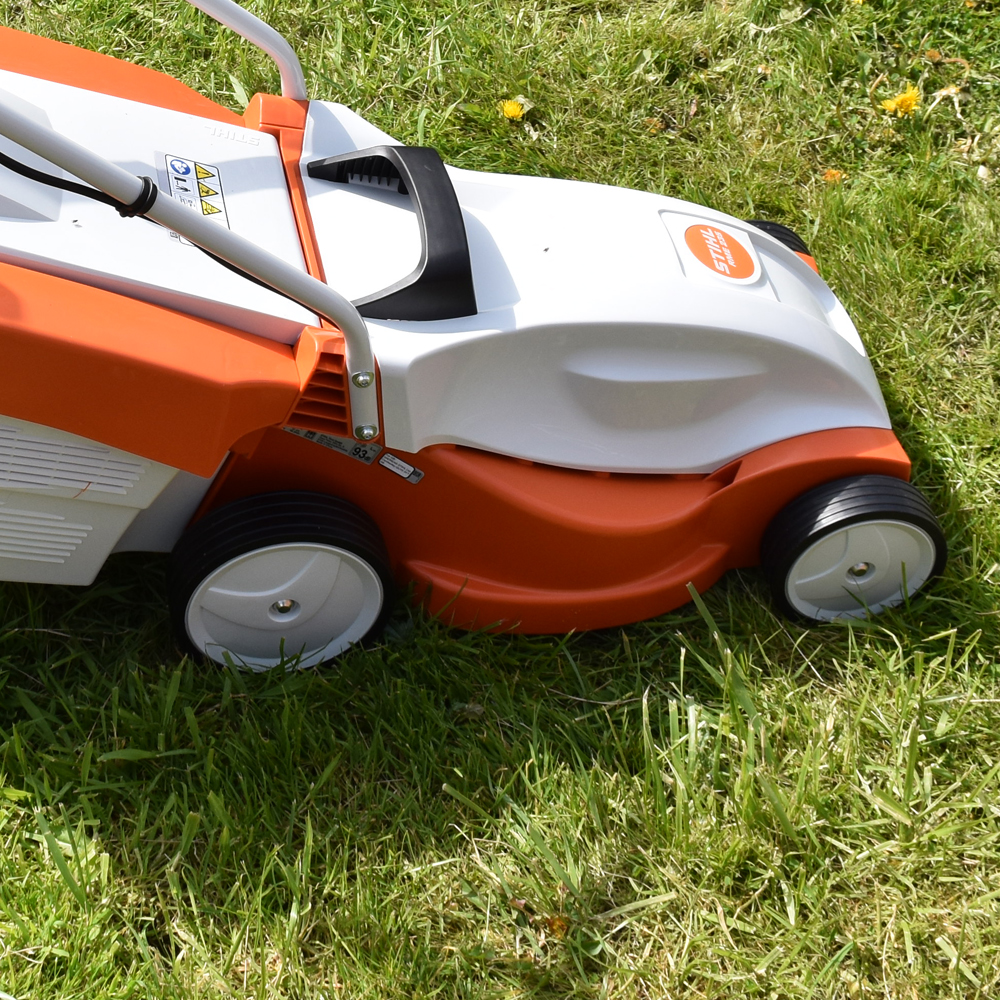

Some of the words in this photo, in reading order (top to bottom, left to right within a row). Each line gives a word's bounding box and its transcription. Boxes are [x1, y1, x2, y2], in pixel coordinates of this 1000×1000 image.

[204, 125, 260, 146] STIHL
[700, 228, 730, 275] STIHL
[351, 447, 368, 459] 93
